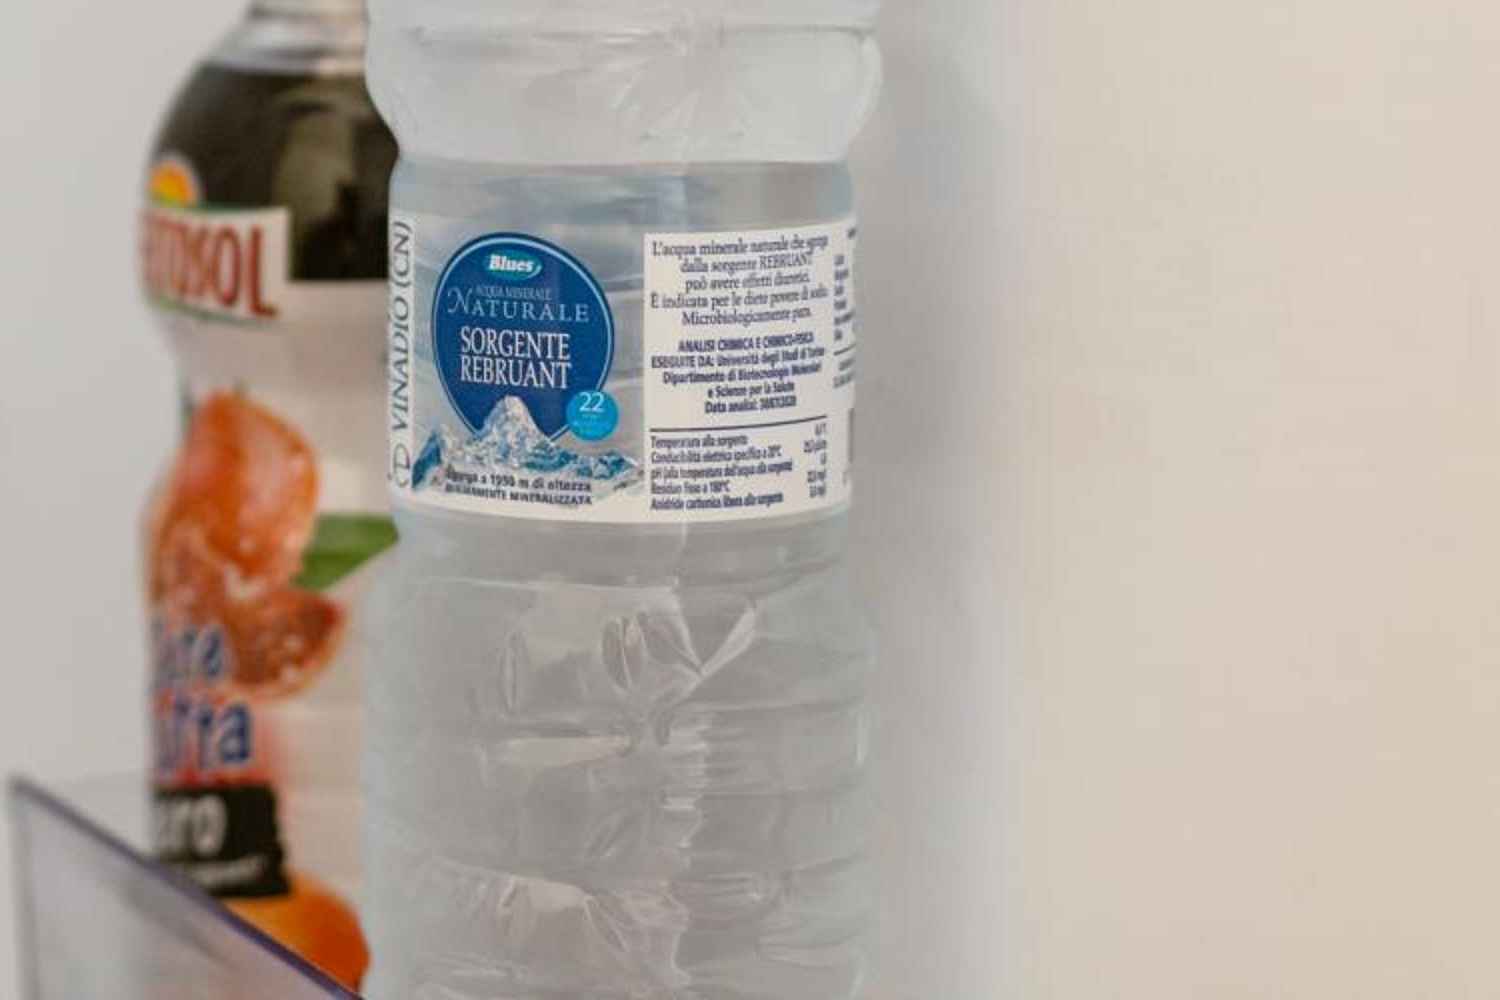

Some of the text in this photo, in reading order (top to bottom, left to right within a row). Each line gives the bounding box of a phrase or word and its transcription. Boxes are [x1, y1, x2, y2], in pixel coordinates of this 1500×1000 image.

[392, 220, 412, 289] (CN)
[653, 241, 697, 259] L'acqua
[700, 238, 748, 255] minerale
[750, 236, 788, 252] naturale
[489, 254, 534, 273] Blues
[681, 257, 708, 272] dalla
[711, 258, 757, 276] sorgente
[759, 251, 814, 270] REBRUANT
[685, 276, 707, 294] può
[709, 278, 739, 290] avere
[447, 286, 589, 322] NATURALE
[662, 293, 708, 308] indicata
[711, 294, 729, 310] per
[732, 292, 742, 306] le
[682, 309, 790, 328] Microbiologicamente
[460, 325, 571, 360] SORGENTE
[678, 339, 715, 351] ANALISI
[392, 298, 409, 431] VINADIO
[651, 355, 695, 368] ESEGUITE
[699, 355, 714, 367] DA:
[460, 355, 572, 389] REBRUANT
[663, 371, 725, 387] Dipartimento
[579, 391, 605, 412] 22
[705, 401, 726, 413] Data
[531, 477, 544, 489] di
